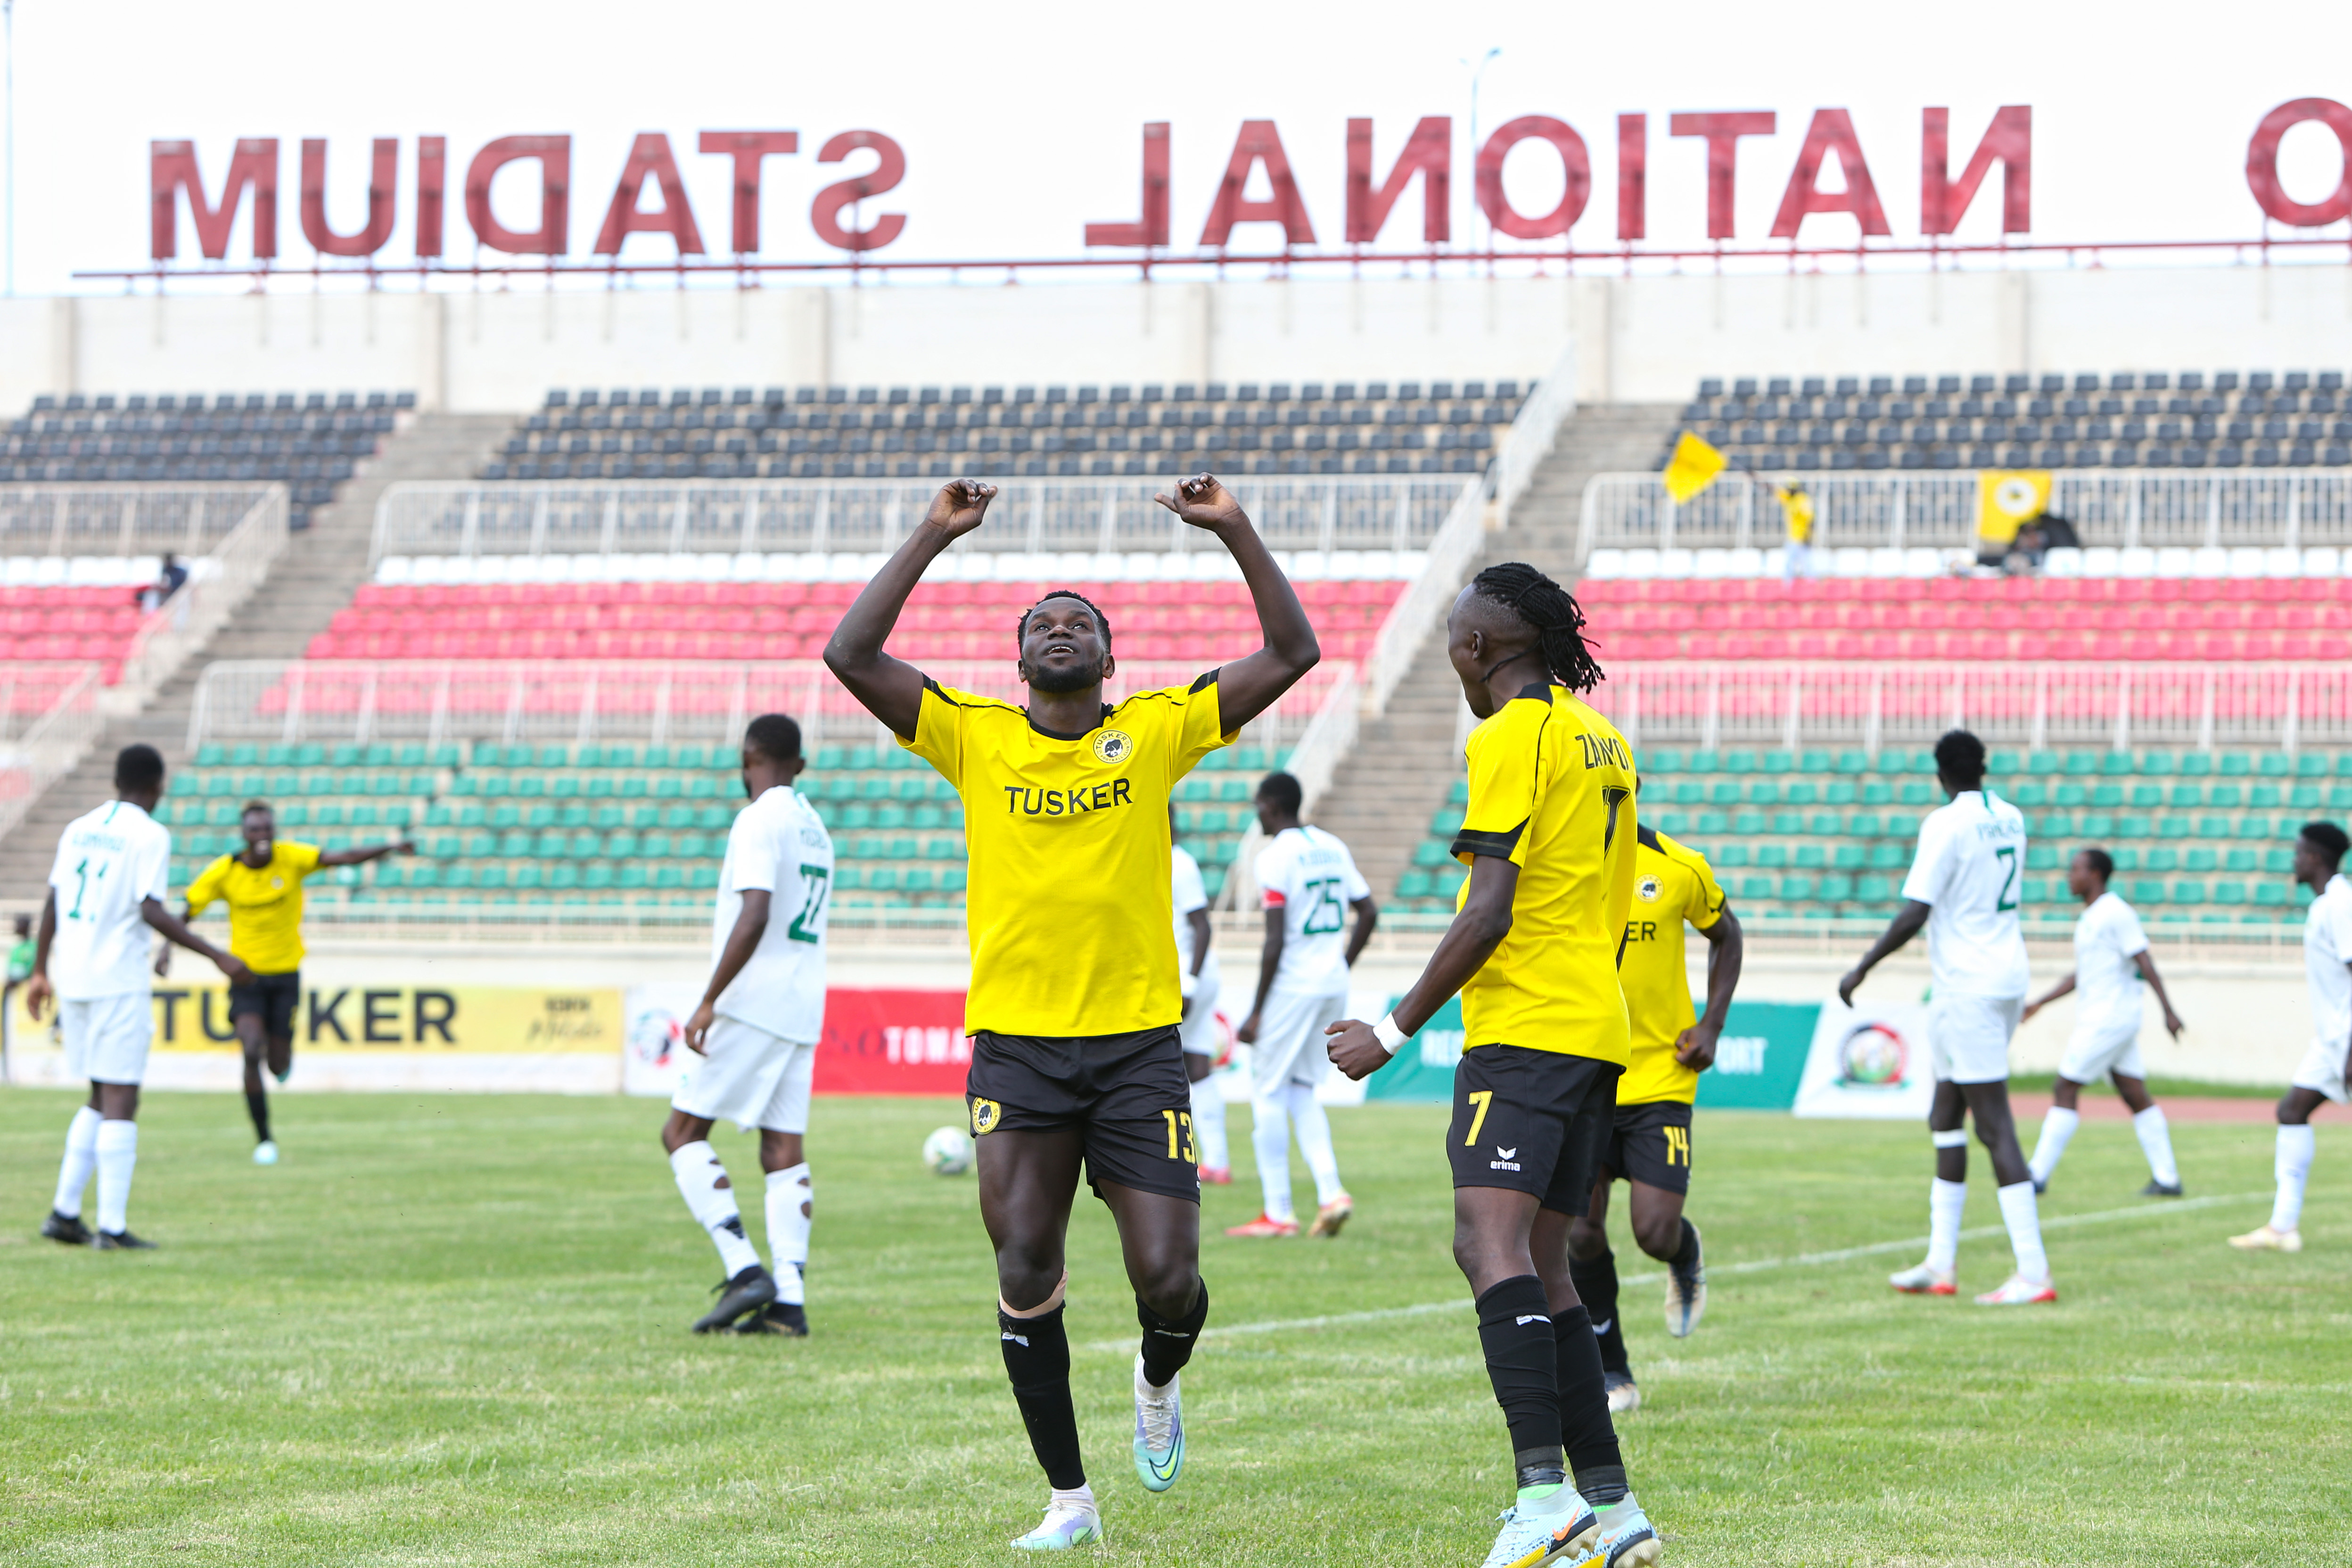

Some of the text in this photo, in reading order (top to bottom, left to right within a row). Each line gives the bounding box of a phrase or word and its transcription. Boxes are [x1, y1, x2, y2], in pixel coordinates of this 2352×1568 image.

[1096, 732, 1127, 749] TUSKER
[1004, 778, 1133, 815] TUSKER
[1304, 877, 1343, 935] 25
[1996, 847, 2017, 912] 2
[153, 989, 458, 1043] TUKER
[1162, 1109, 1196, 1164] 13
[1464, 1090, 1493, 1147] 7
[1490, 1159, 1521, 1172] erima
[1662, 1125, 1689, 1167] 14
